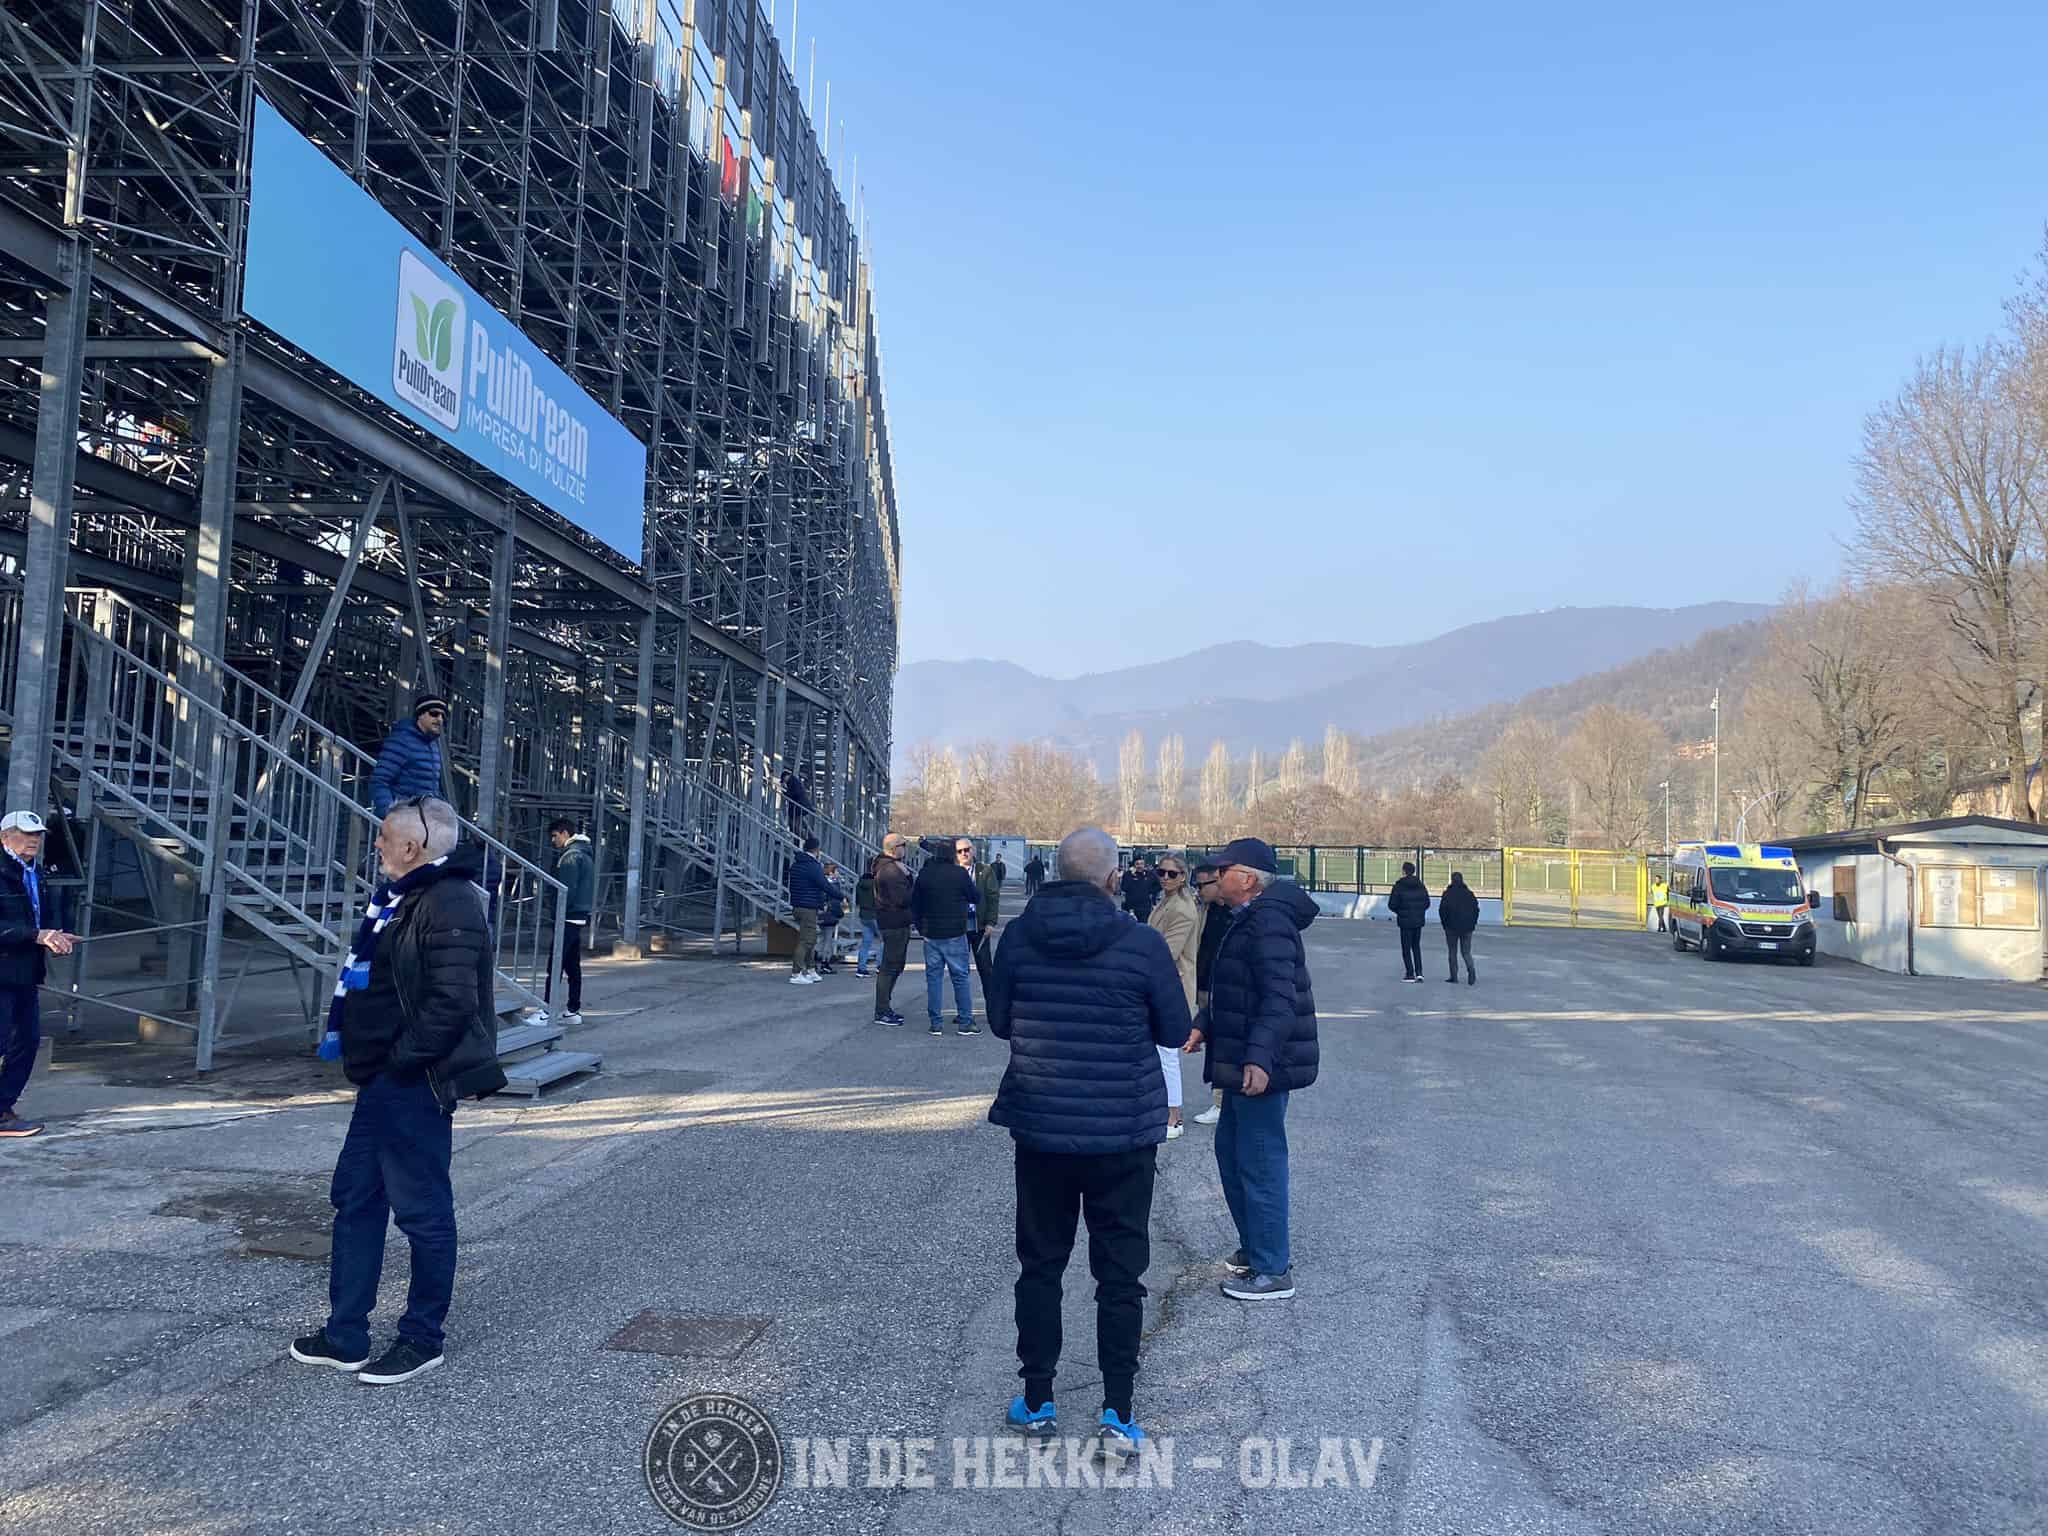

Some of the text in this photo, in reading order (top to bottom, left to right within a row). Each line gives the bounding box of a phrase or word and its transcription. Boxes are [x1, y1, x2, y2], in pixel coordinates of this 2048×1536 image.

[398, 349, 457, 417] PuliDream
[469, 319, 588, 481] PuliDream
[467, 401, 585, 505] IMPRESA DI PULIZIE
